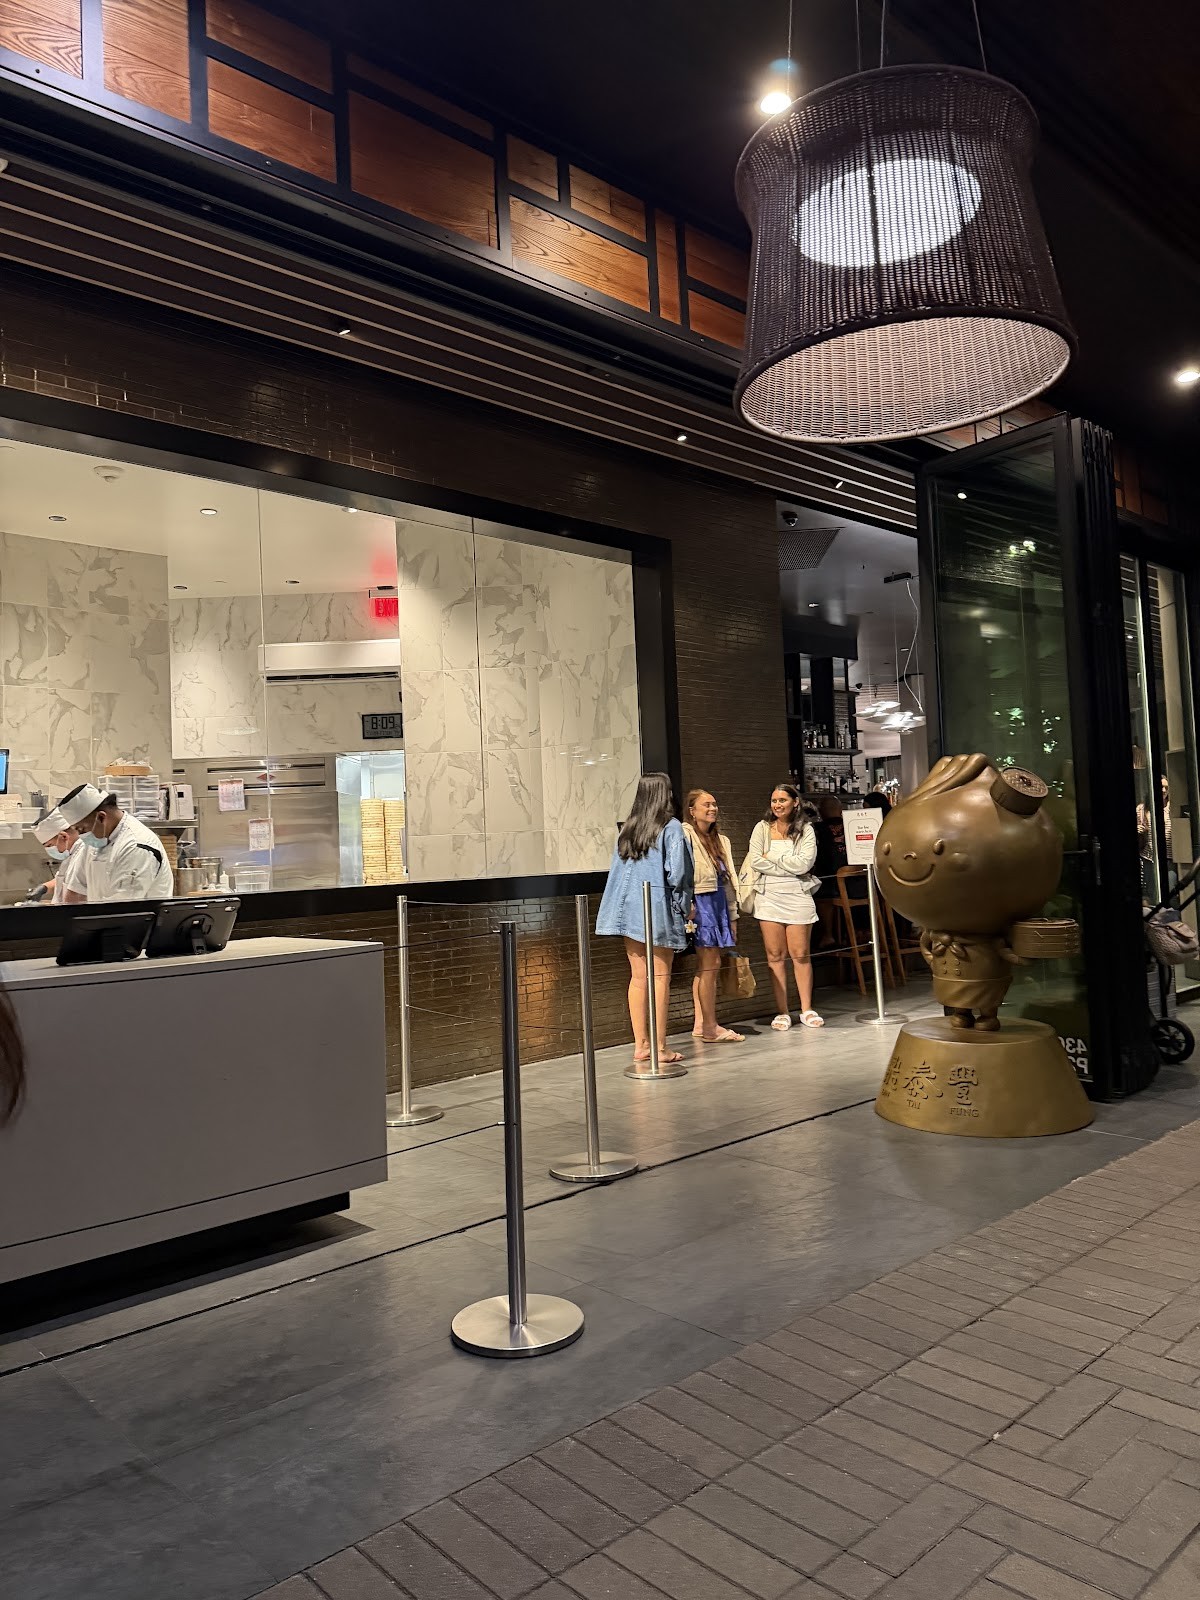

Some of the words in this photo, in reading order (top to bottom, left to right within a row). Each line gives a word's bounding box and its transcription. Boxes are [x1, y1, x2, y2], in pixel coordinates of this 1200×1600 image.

[371, 715, 395, 730] 8:09
[907, 1099, 921, 1110] TAI
[949, 1107, 979, 1118] FUNG
